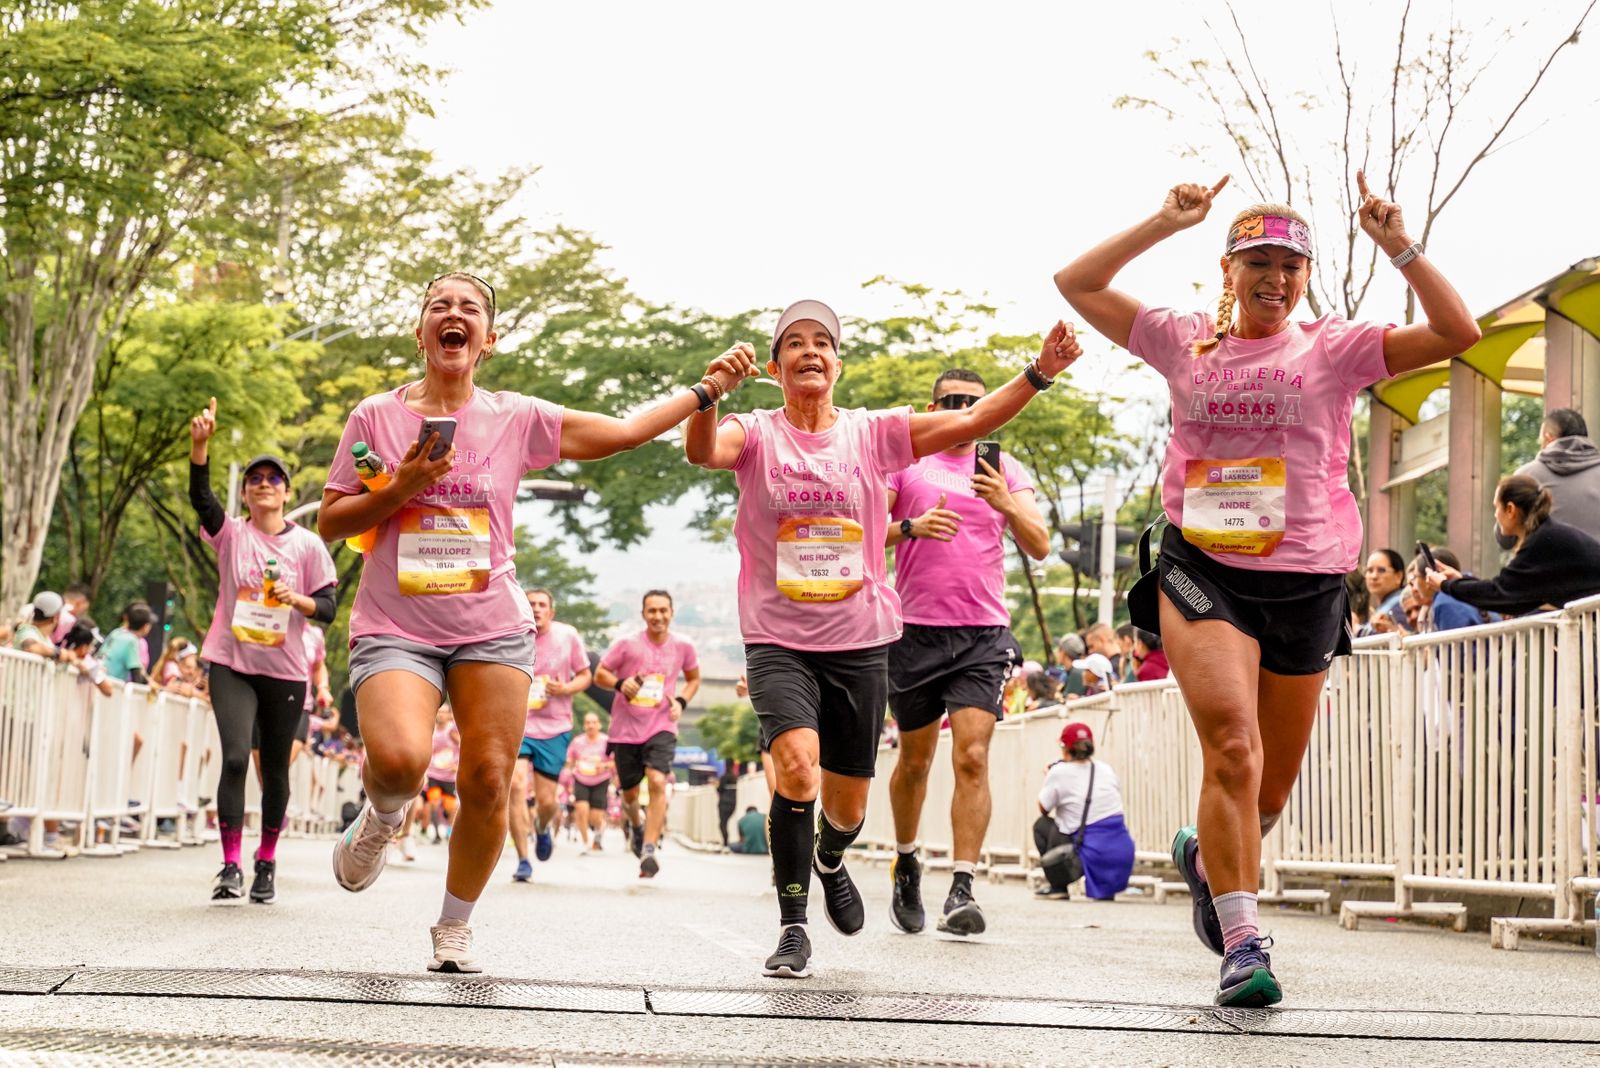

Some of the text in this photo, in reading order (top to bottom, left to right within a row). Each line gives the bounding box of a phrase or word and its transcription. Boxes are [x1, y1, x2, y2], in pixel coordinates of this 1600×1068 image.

[1194, 367, 1303, 389] CARRERA
[1227, 382, 1264, 391] DE LAS
[1187, 391, 1304, 425] ALMA
[1208, 402, 1276, 415] ROSAS
[802, 473, 812, 481] DE
[788, 491, 845, 503] ROSAS
[1218, 502, 1251, 510] ANDRE
[1224, 518, 1245, 526] 14775
[1211, 543, 1256, 551] Alkomprar
[418, 547, 471, 556] KARU LOPEZ
[799, 554, 840, 562] MIS HIJOS
[811, 569, 829, 577] 12632
[426, 582, 467, 590] Alkomprar
[1165, 564, 1213, 614] RUNNING
[801, 591, 839, 599] Alkomprar
